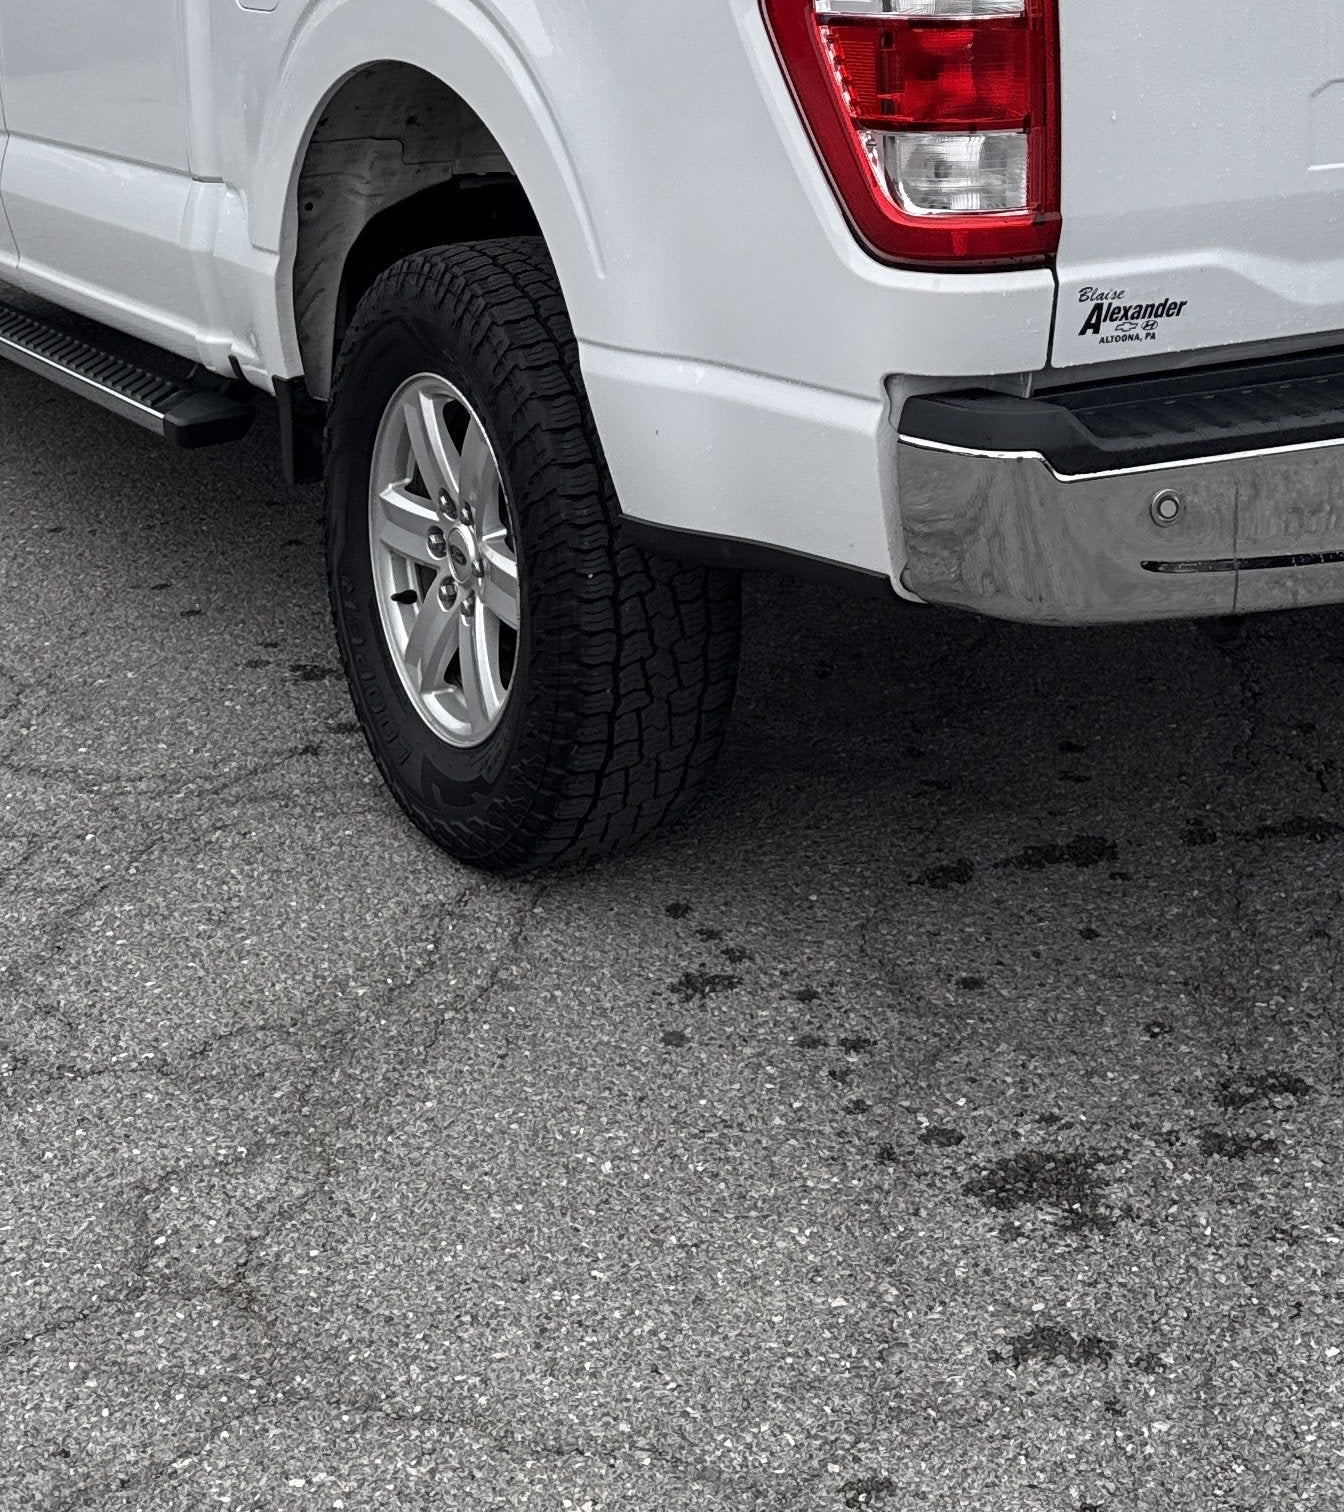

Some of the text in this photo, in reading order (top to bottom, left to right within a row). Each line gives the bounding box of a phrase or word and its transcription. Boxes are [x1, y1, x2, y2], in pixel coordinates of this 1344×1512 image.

[1078, 287, 1125, 303] Blaise
[1078, 298, 1188, 336] Alexander
[1099, 332, 1156, 344] ALTOONA, PA
